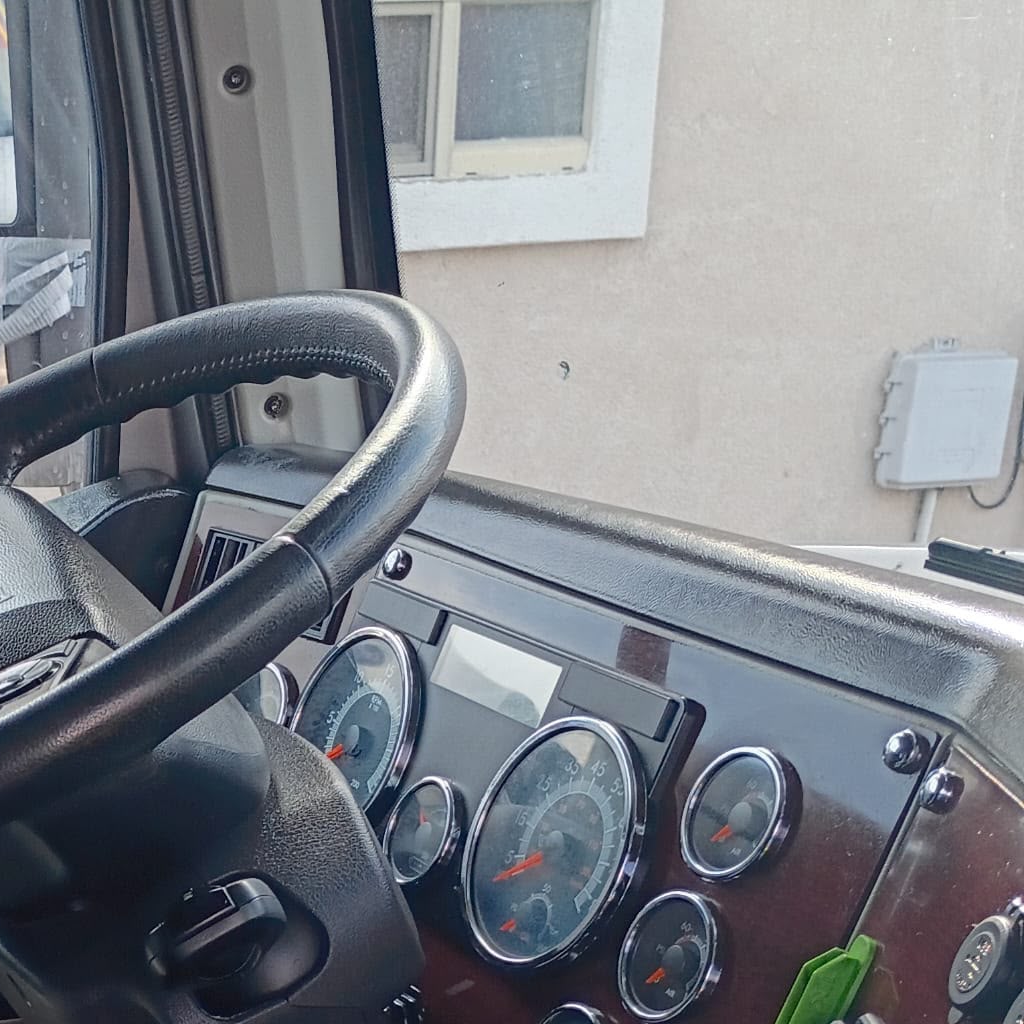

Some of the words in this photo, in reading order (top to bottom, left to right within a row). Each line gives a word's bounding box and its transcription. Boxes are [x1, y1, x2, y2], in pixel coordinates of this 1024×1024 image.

[326, 710, 336, 725] 5
[590, 759, 608, 777] 45
[537, 774, 552, 792] 25
[514, 810, 527, 826] 15
